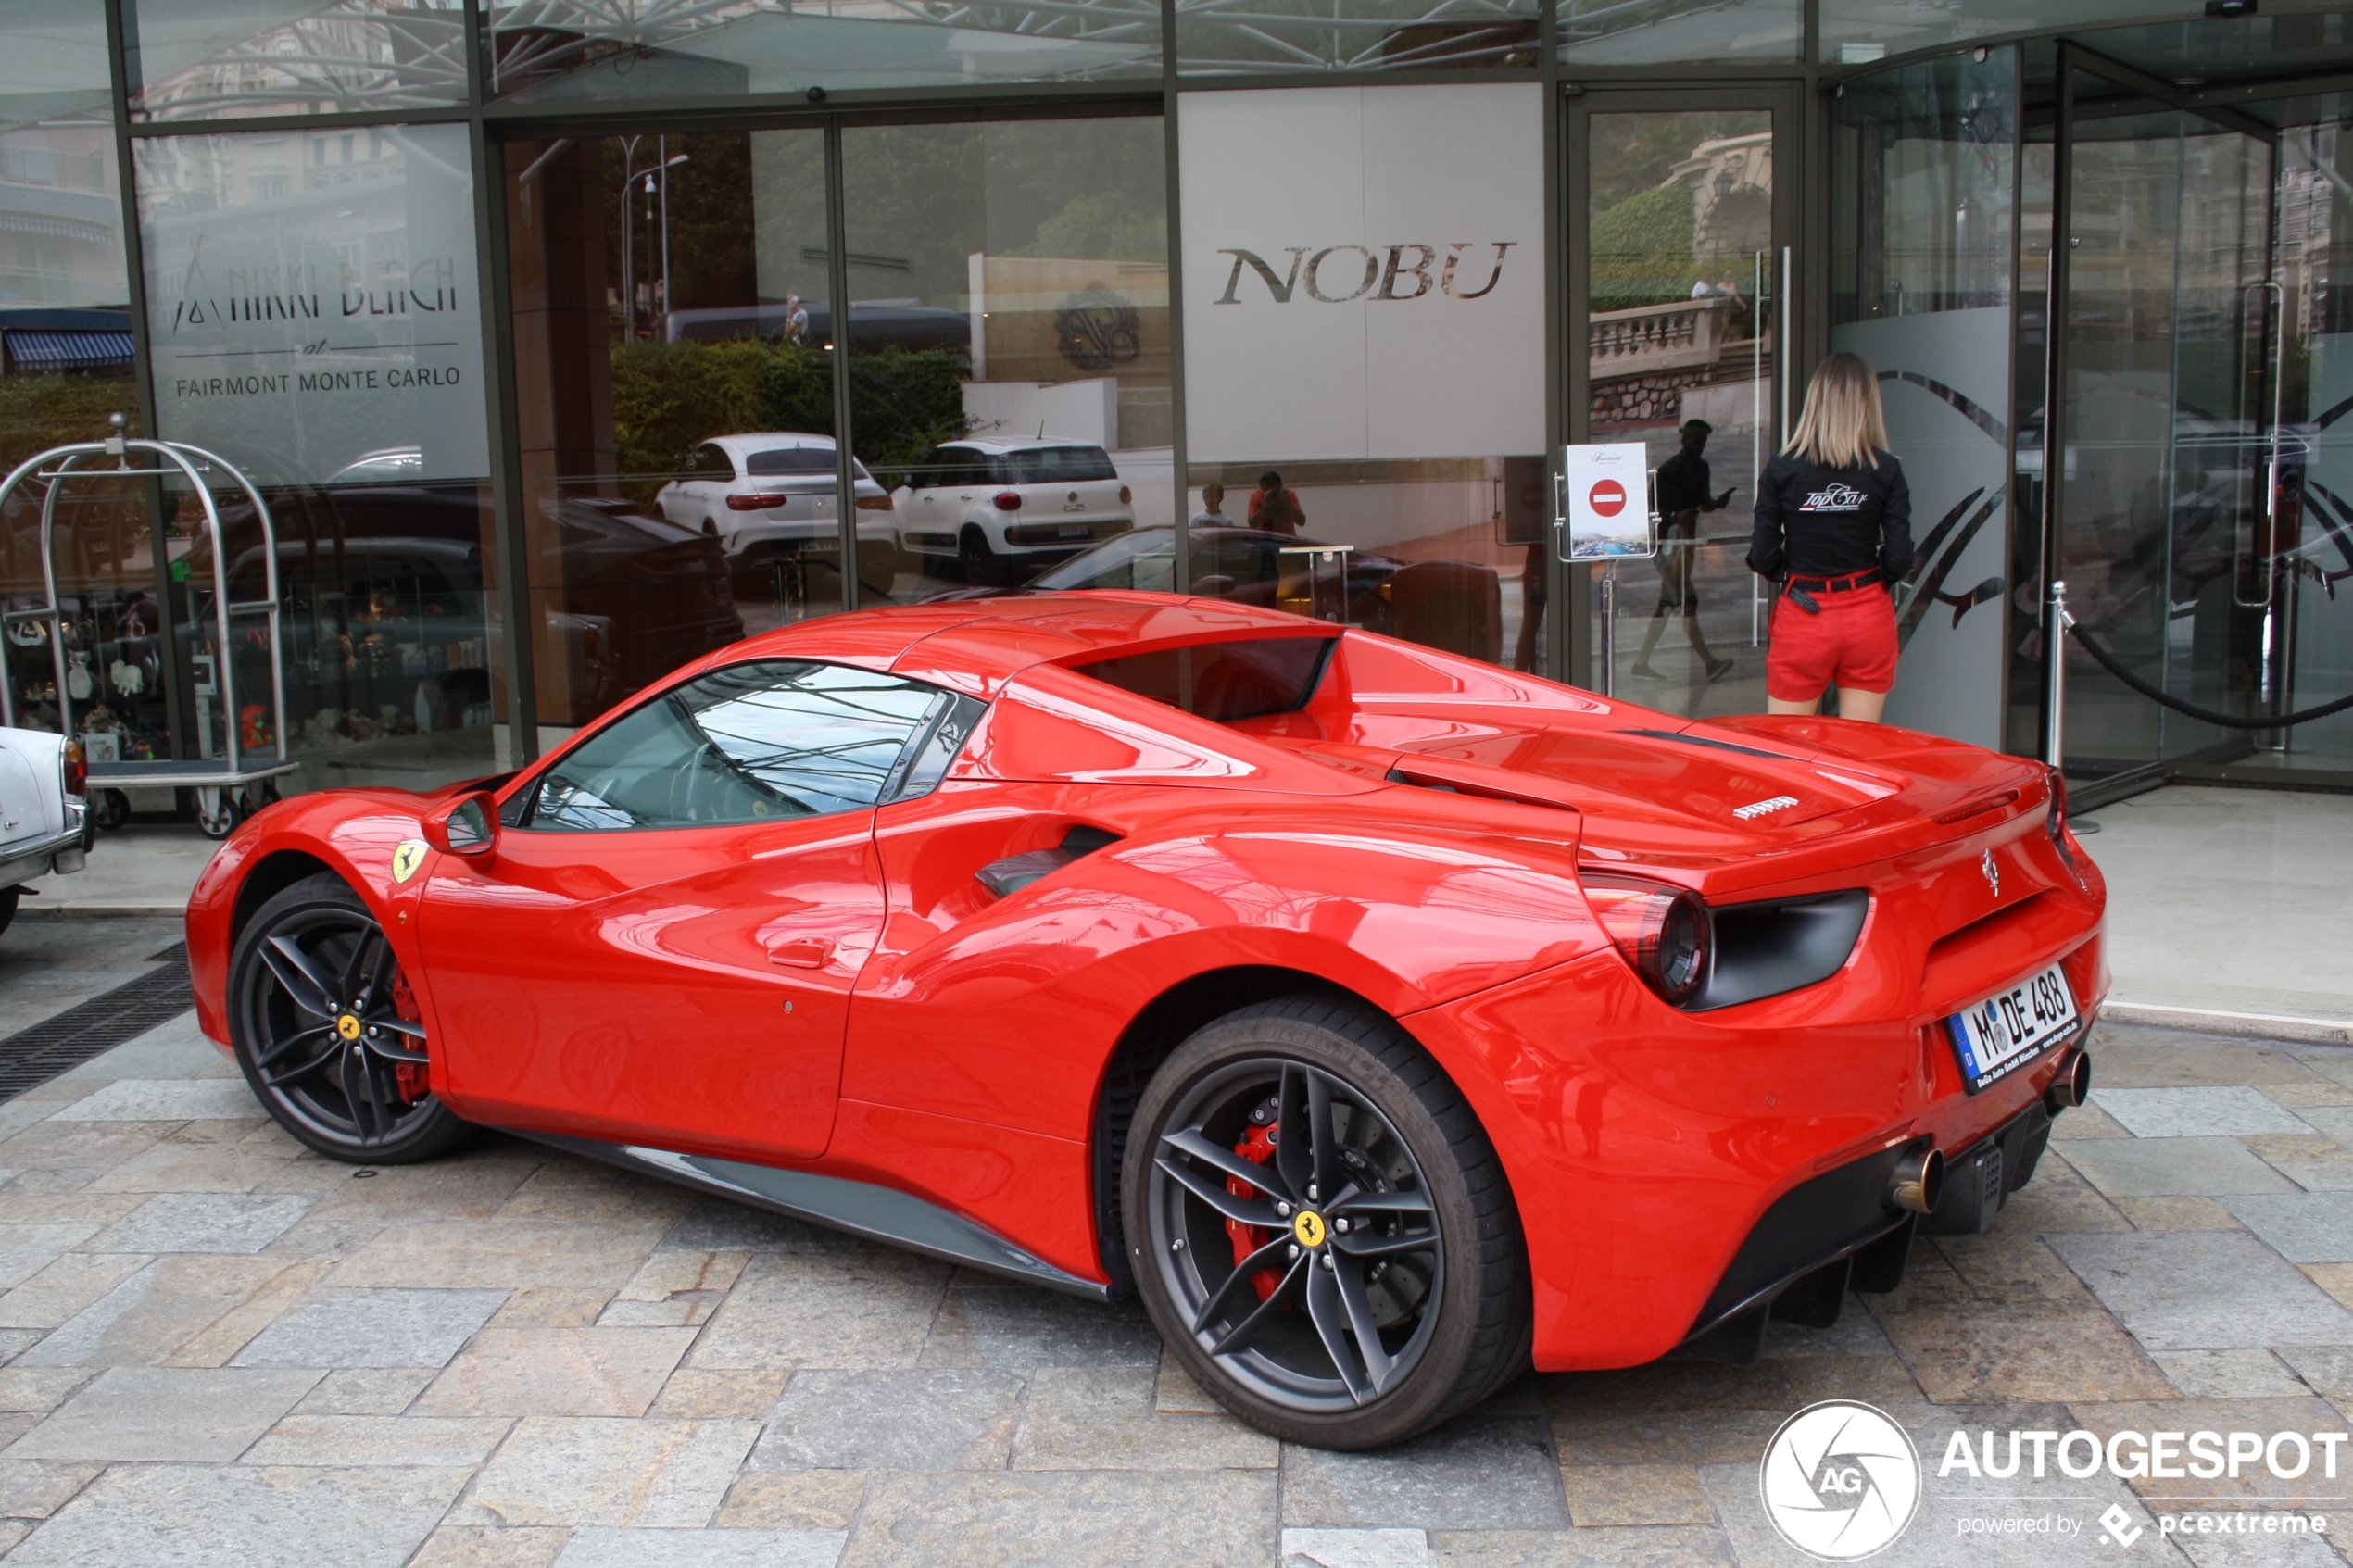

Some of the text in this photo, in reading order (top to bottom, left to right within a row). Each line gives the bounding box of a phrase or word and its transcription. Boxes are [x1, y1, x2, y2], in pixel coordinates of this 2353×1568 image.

[229, 257, 457, 321] NIKKI BEACH
[1213, 242, 1518, 305] NOBU
[303, 339, 327, 356] at
[177, 367, 460, 396] FAIRMONT MONTE CARLO
[1972, 971, 2066, 1060] M DE 488
[1253, 1024, 1355, 1064] MICHELIN
[1965, 1052, 1973, 1067] D
[1992, 1067, 2005, 1080] Auto
[2004, 1057, 2019, 1073] GmbH
